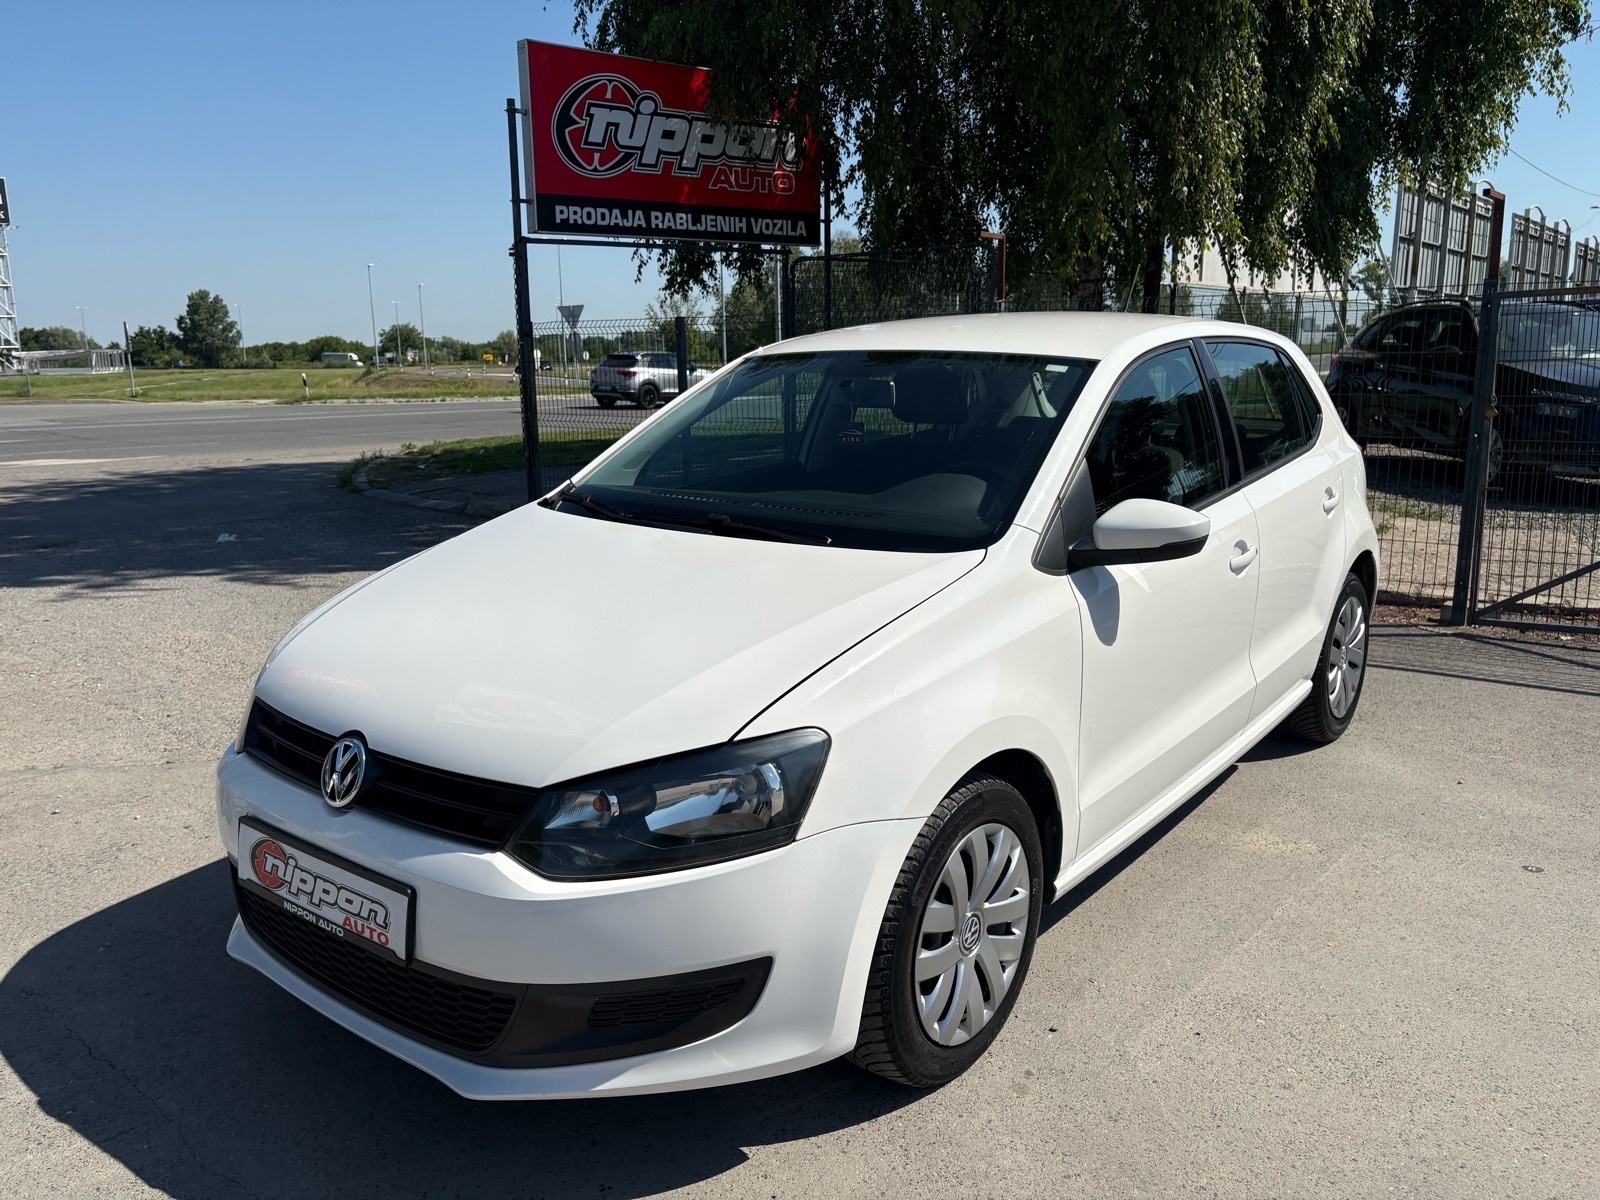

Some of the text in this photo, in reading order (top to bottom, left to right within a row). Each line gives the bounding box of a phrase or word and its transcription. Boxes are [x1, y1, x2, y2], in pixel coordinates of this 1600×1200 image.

[708, 165, 796, 195] AUTO
[554, 204, 807, 237] PRODAJA RABLJENIH VOZILA
[263, 851, 391, 931] nippon
[283, 900, 344, 938] NIPPON AUTO
[342, 915, 390, 947] AUTO
